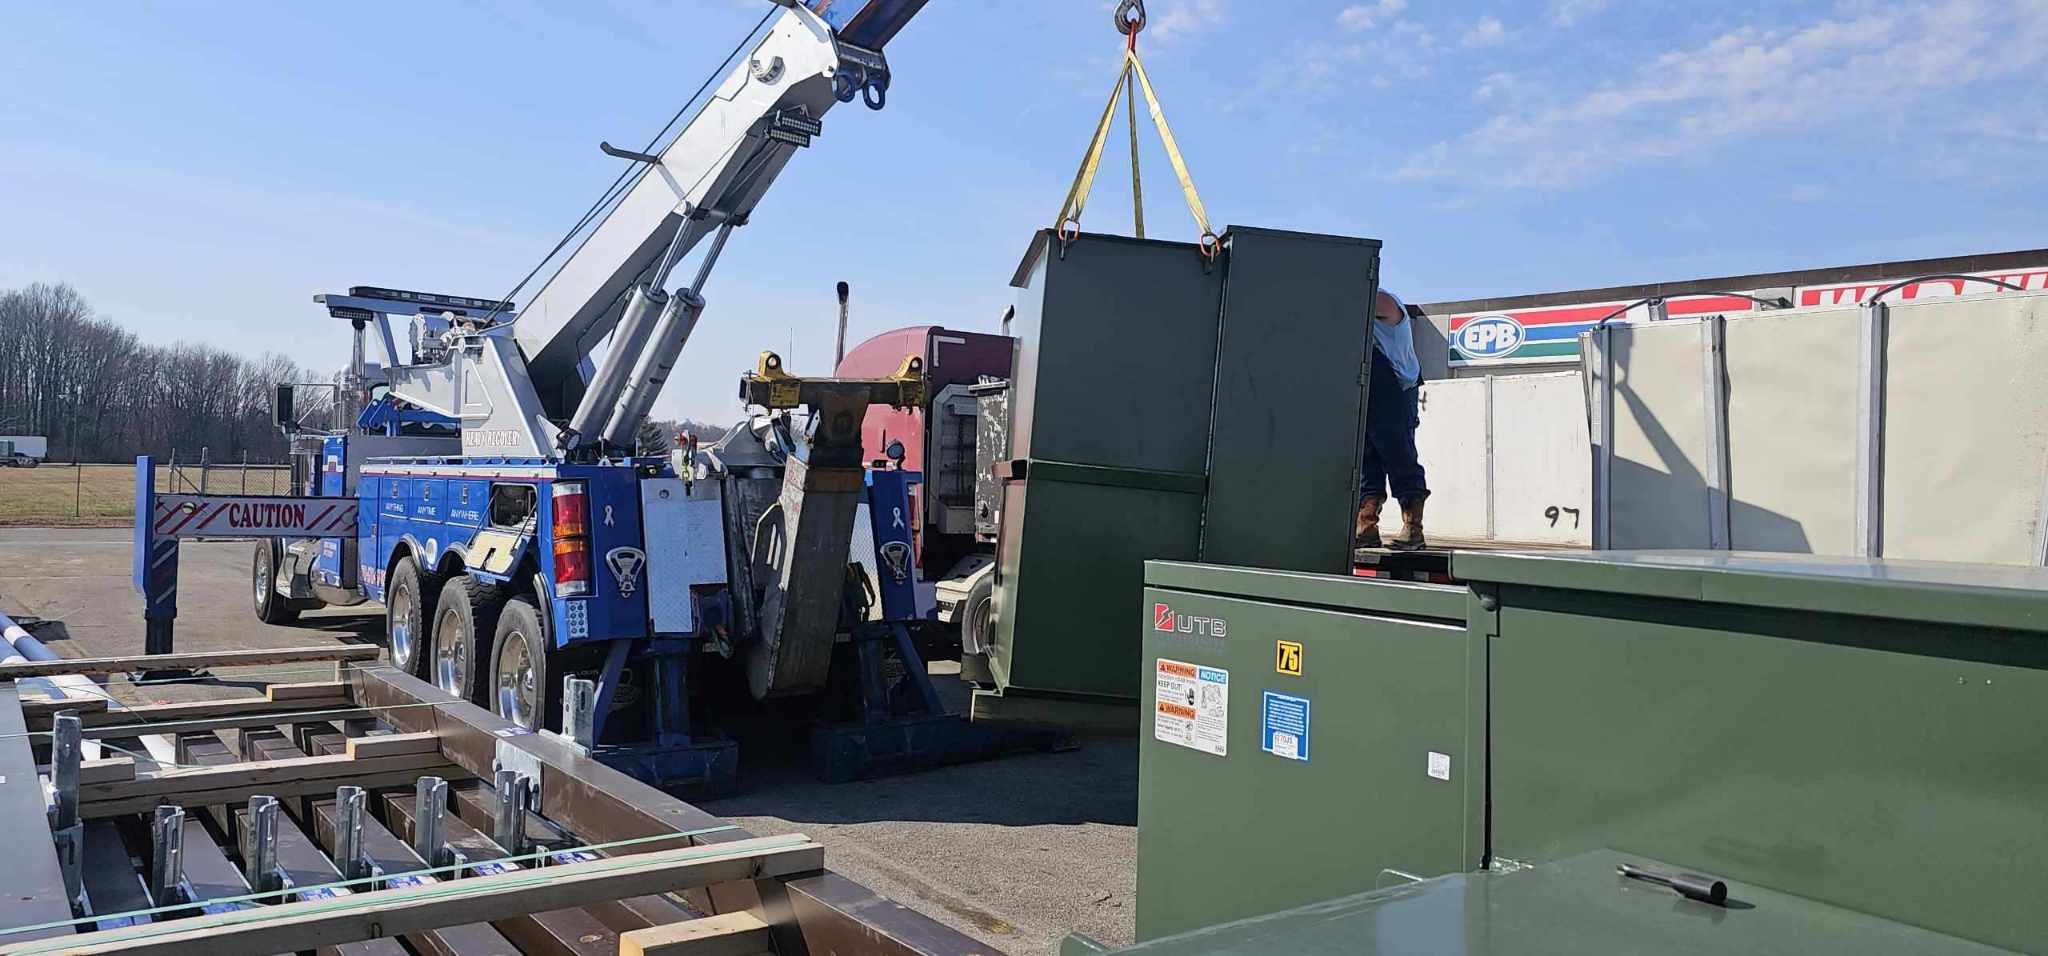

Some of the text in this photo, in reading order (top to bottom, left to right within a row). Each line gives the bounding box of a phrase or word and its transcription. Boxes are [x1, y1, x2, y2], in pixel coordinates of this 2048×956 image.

[1464, 322, 1517, 350] EPB
[229, 503, 306, 529] CAUTION
[1545, 506, 1580, 529] 97
[1177, 614, 1227, 637] UTB
[1280, 644, 1298, 671] 75
[1166, 664, 1195, 677] WARNING
[1200, 671, 1227, 683] NOTICE
[1165, 704, 1194, 718] WARNING
